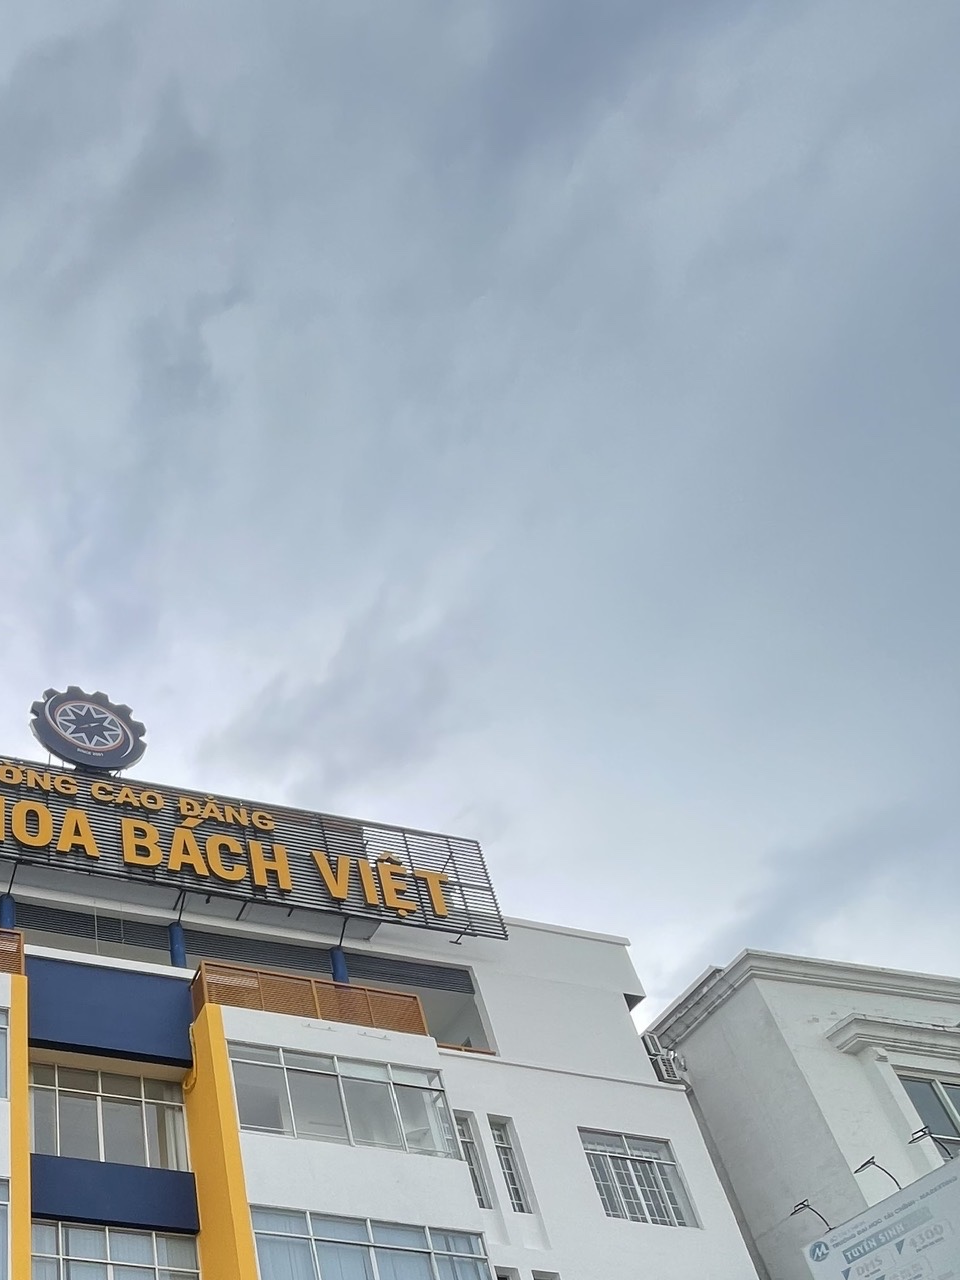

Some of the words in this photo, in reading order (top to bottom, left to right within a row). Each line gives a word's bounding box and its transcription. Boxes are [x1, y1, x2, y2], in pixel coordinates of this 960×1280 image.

[89, 781, 165, 811] CAO
[121, 816, 293, 893] BÁCH
[310, 850, 449, 918] VIỆT
[878, 1223, 904, 1243] SINH
